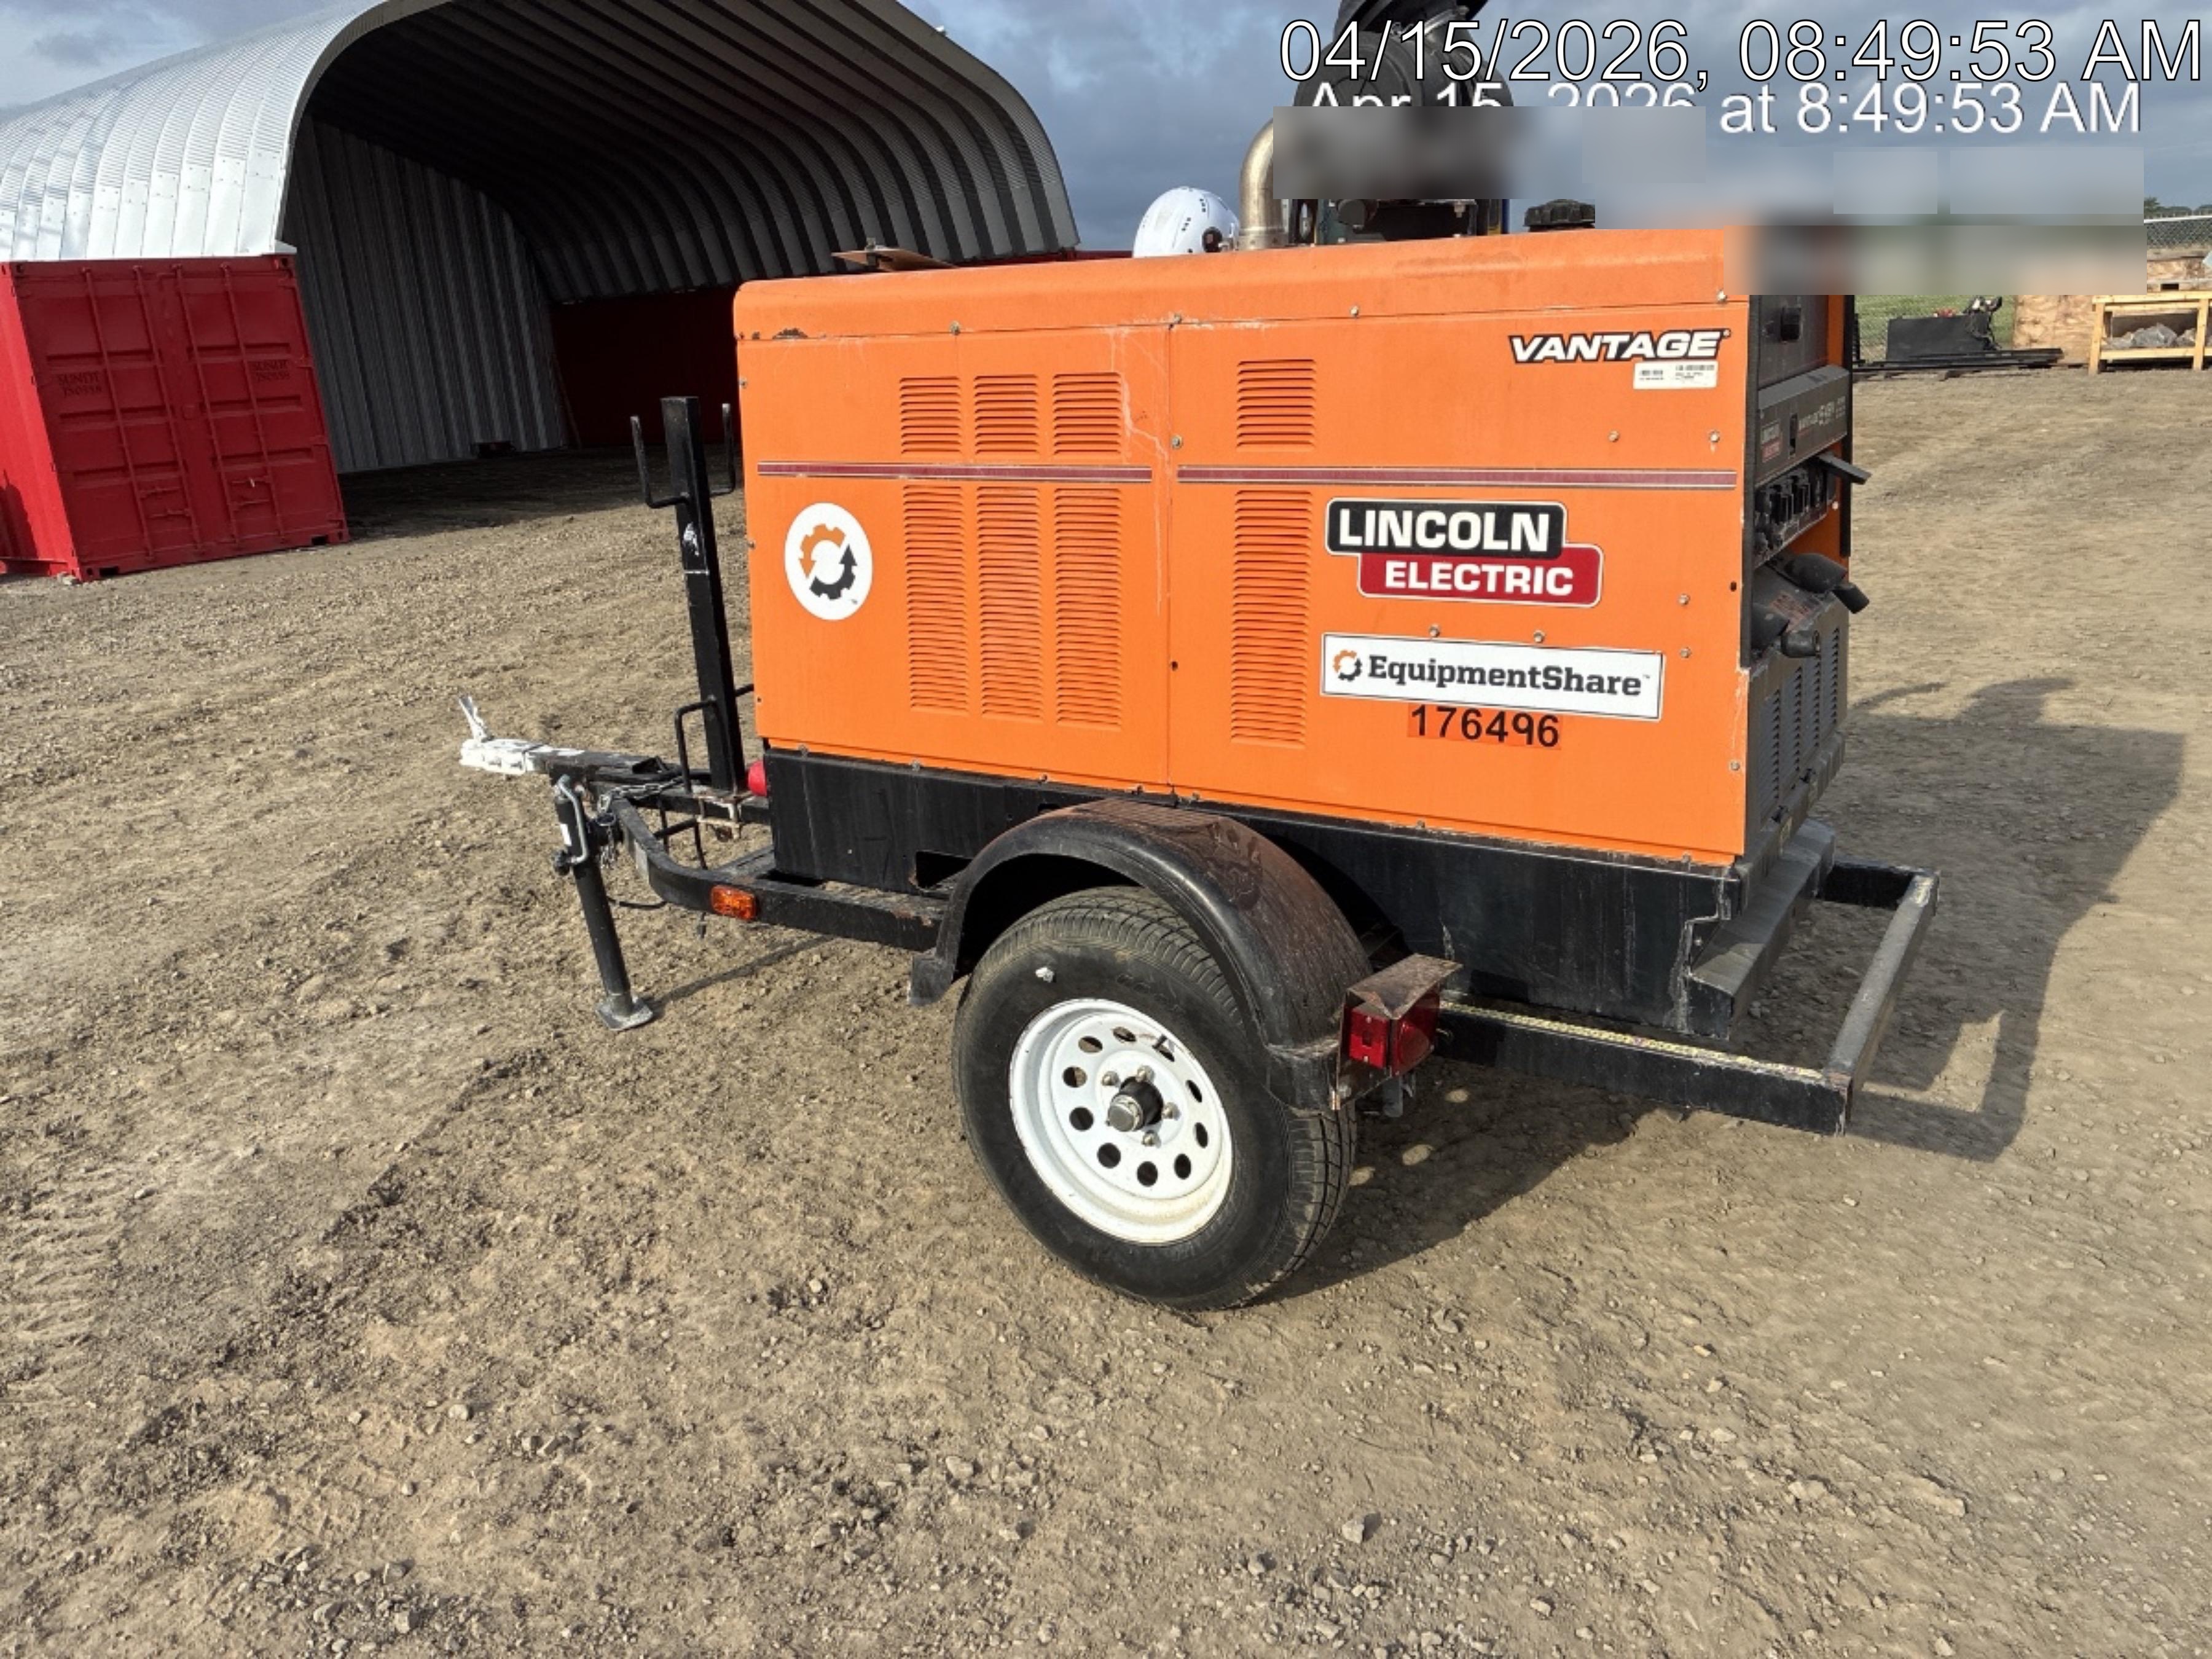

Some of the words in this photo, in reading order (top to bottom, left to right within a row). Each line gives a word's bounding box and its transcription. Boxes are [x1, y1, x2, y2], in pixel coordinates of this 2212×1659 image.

[1510, 330, 1722, 363] VANTAGE
[1339, 508, 1549, 552] LINCOLN
[1385, 560, 1574, 596] ELECTRIC
[1368, 655, 1641, 696] EquipmentShare
[1411, 704, 1559, 747] 176496
